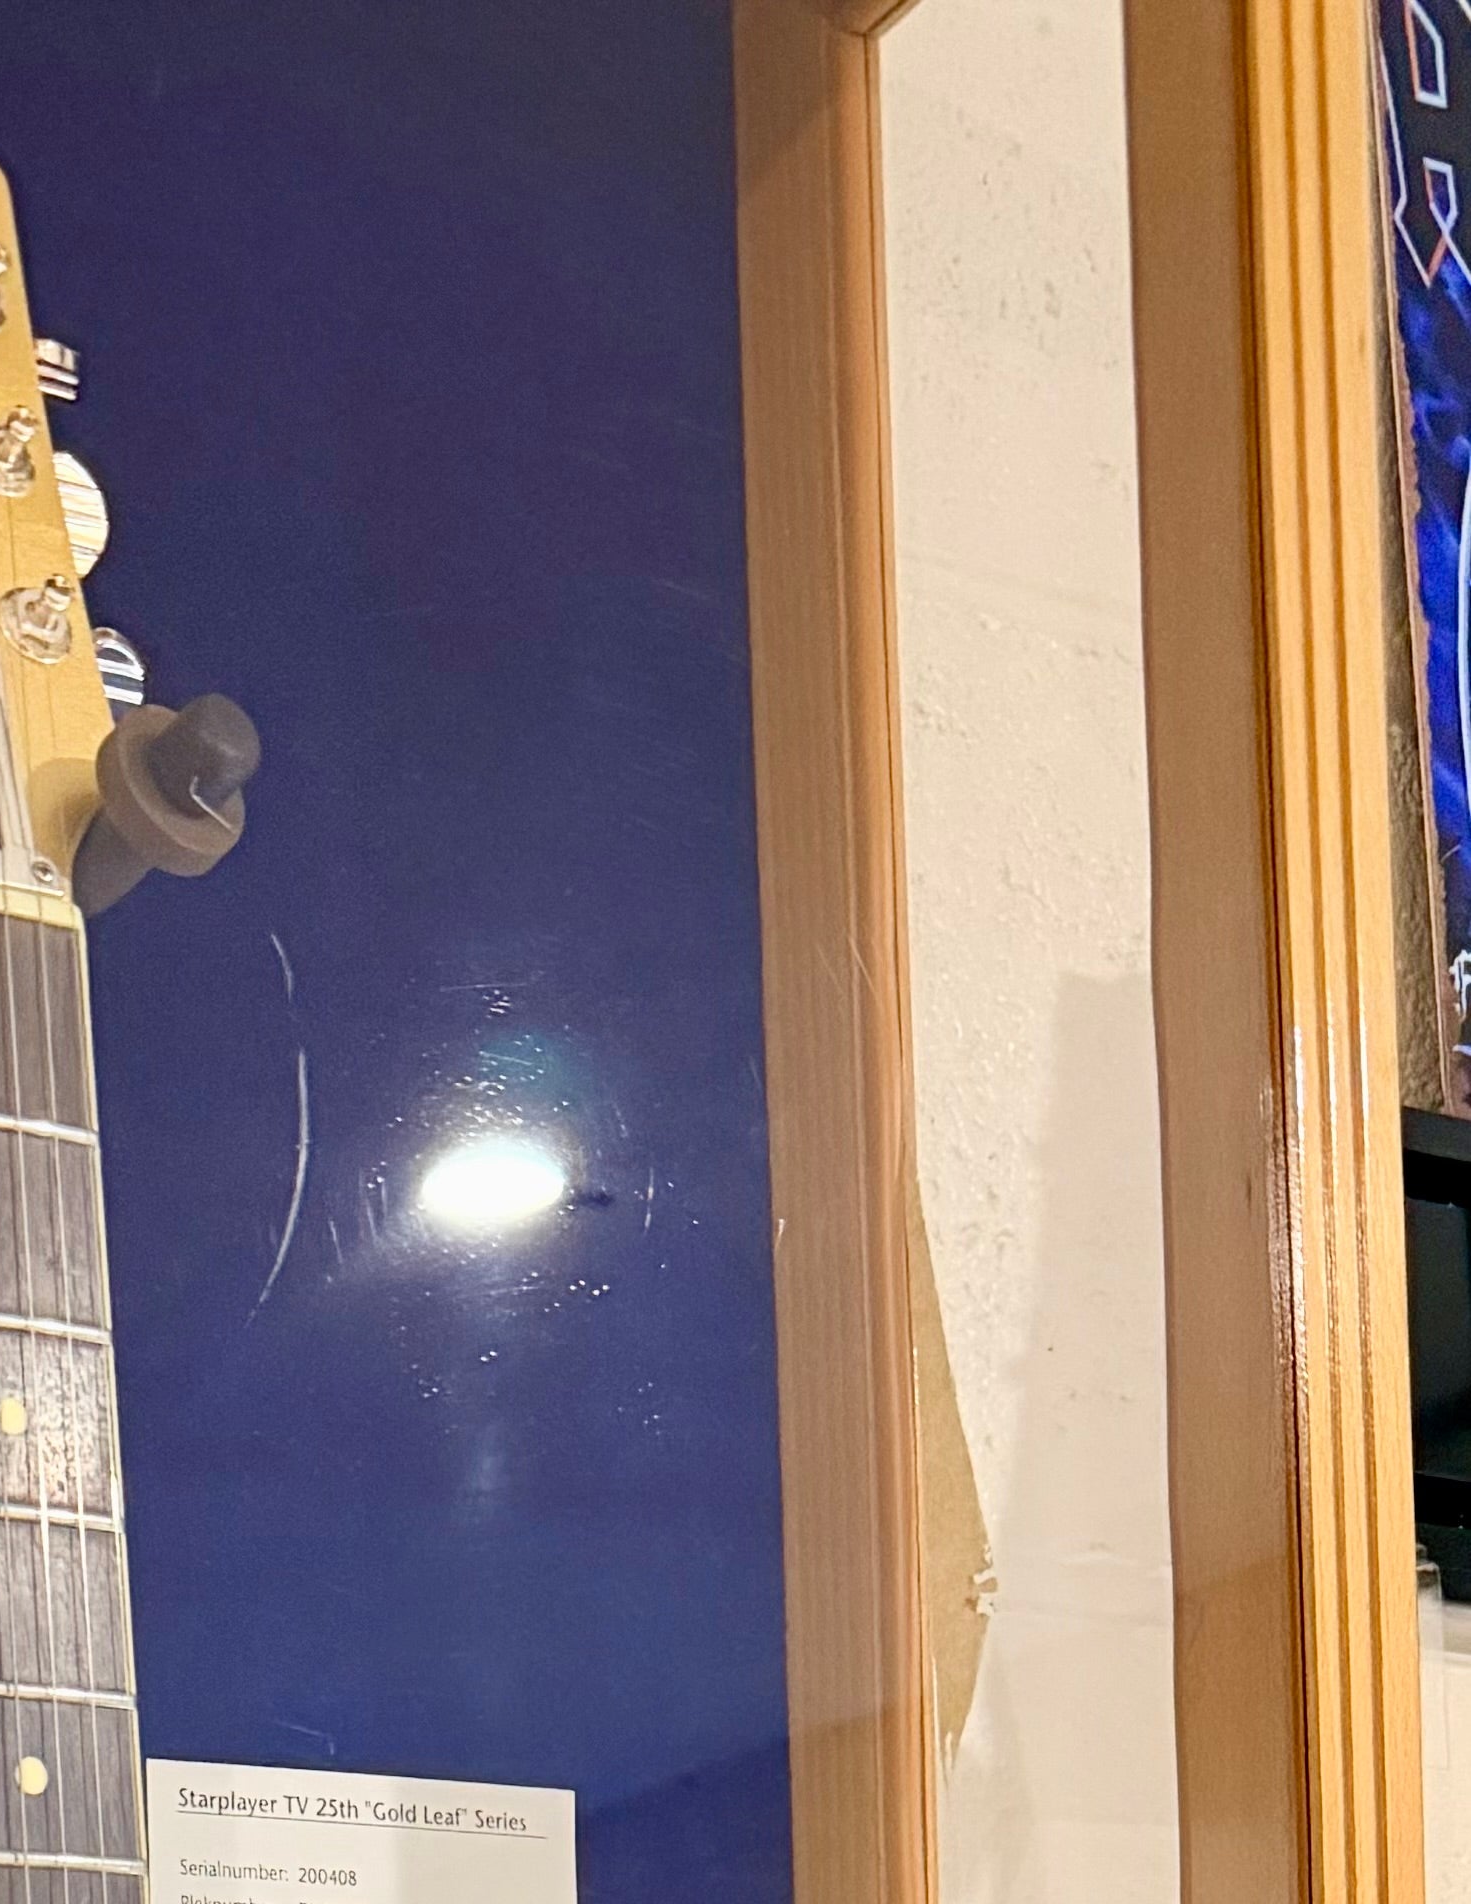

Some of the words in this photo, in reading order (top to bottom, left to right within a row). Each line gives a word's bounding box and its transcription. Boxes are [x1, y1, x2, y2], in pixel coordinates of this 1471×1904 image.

[178, 1788, 277, 1816] Starplayer
[283, 1795, 309, 1814] TV
[316, 1798, 359, 1819] 25th
[365, 1801, 417, 1823] "Gold
[424, 1805, 467, 1826] Leaf"
[475, 1810, 526, 1831] Series
[179, 1858, 289, 1882] Serialnumber:
[298, 1867, 357, 1887] 200408
